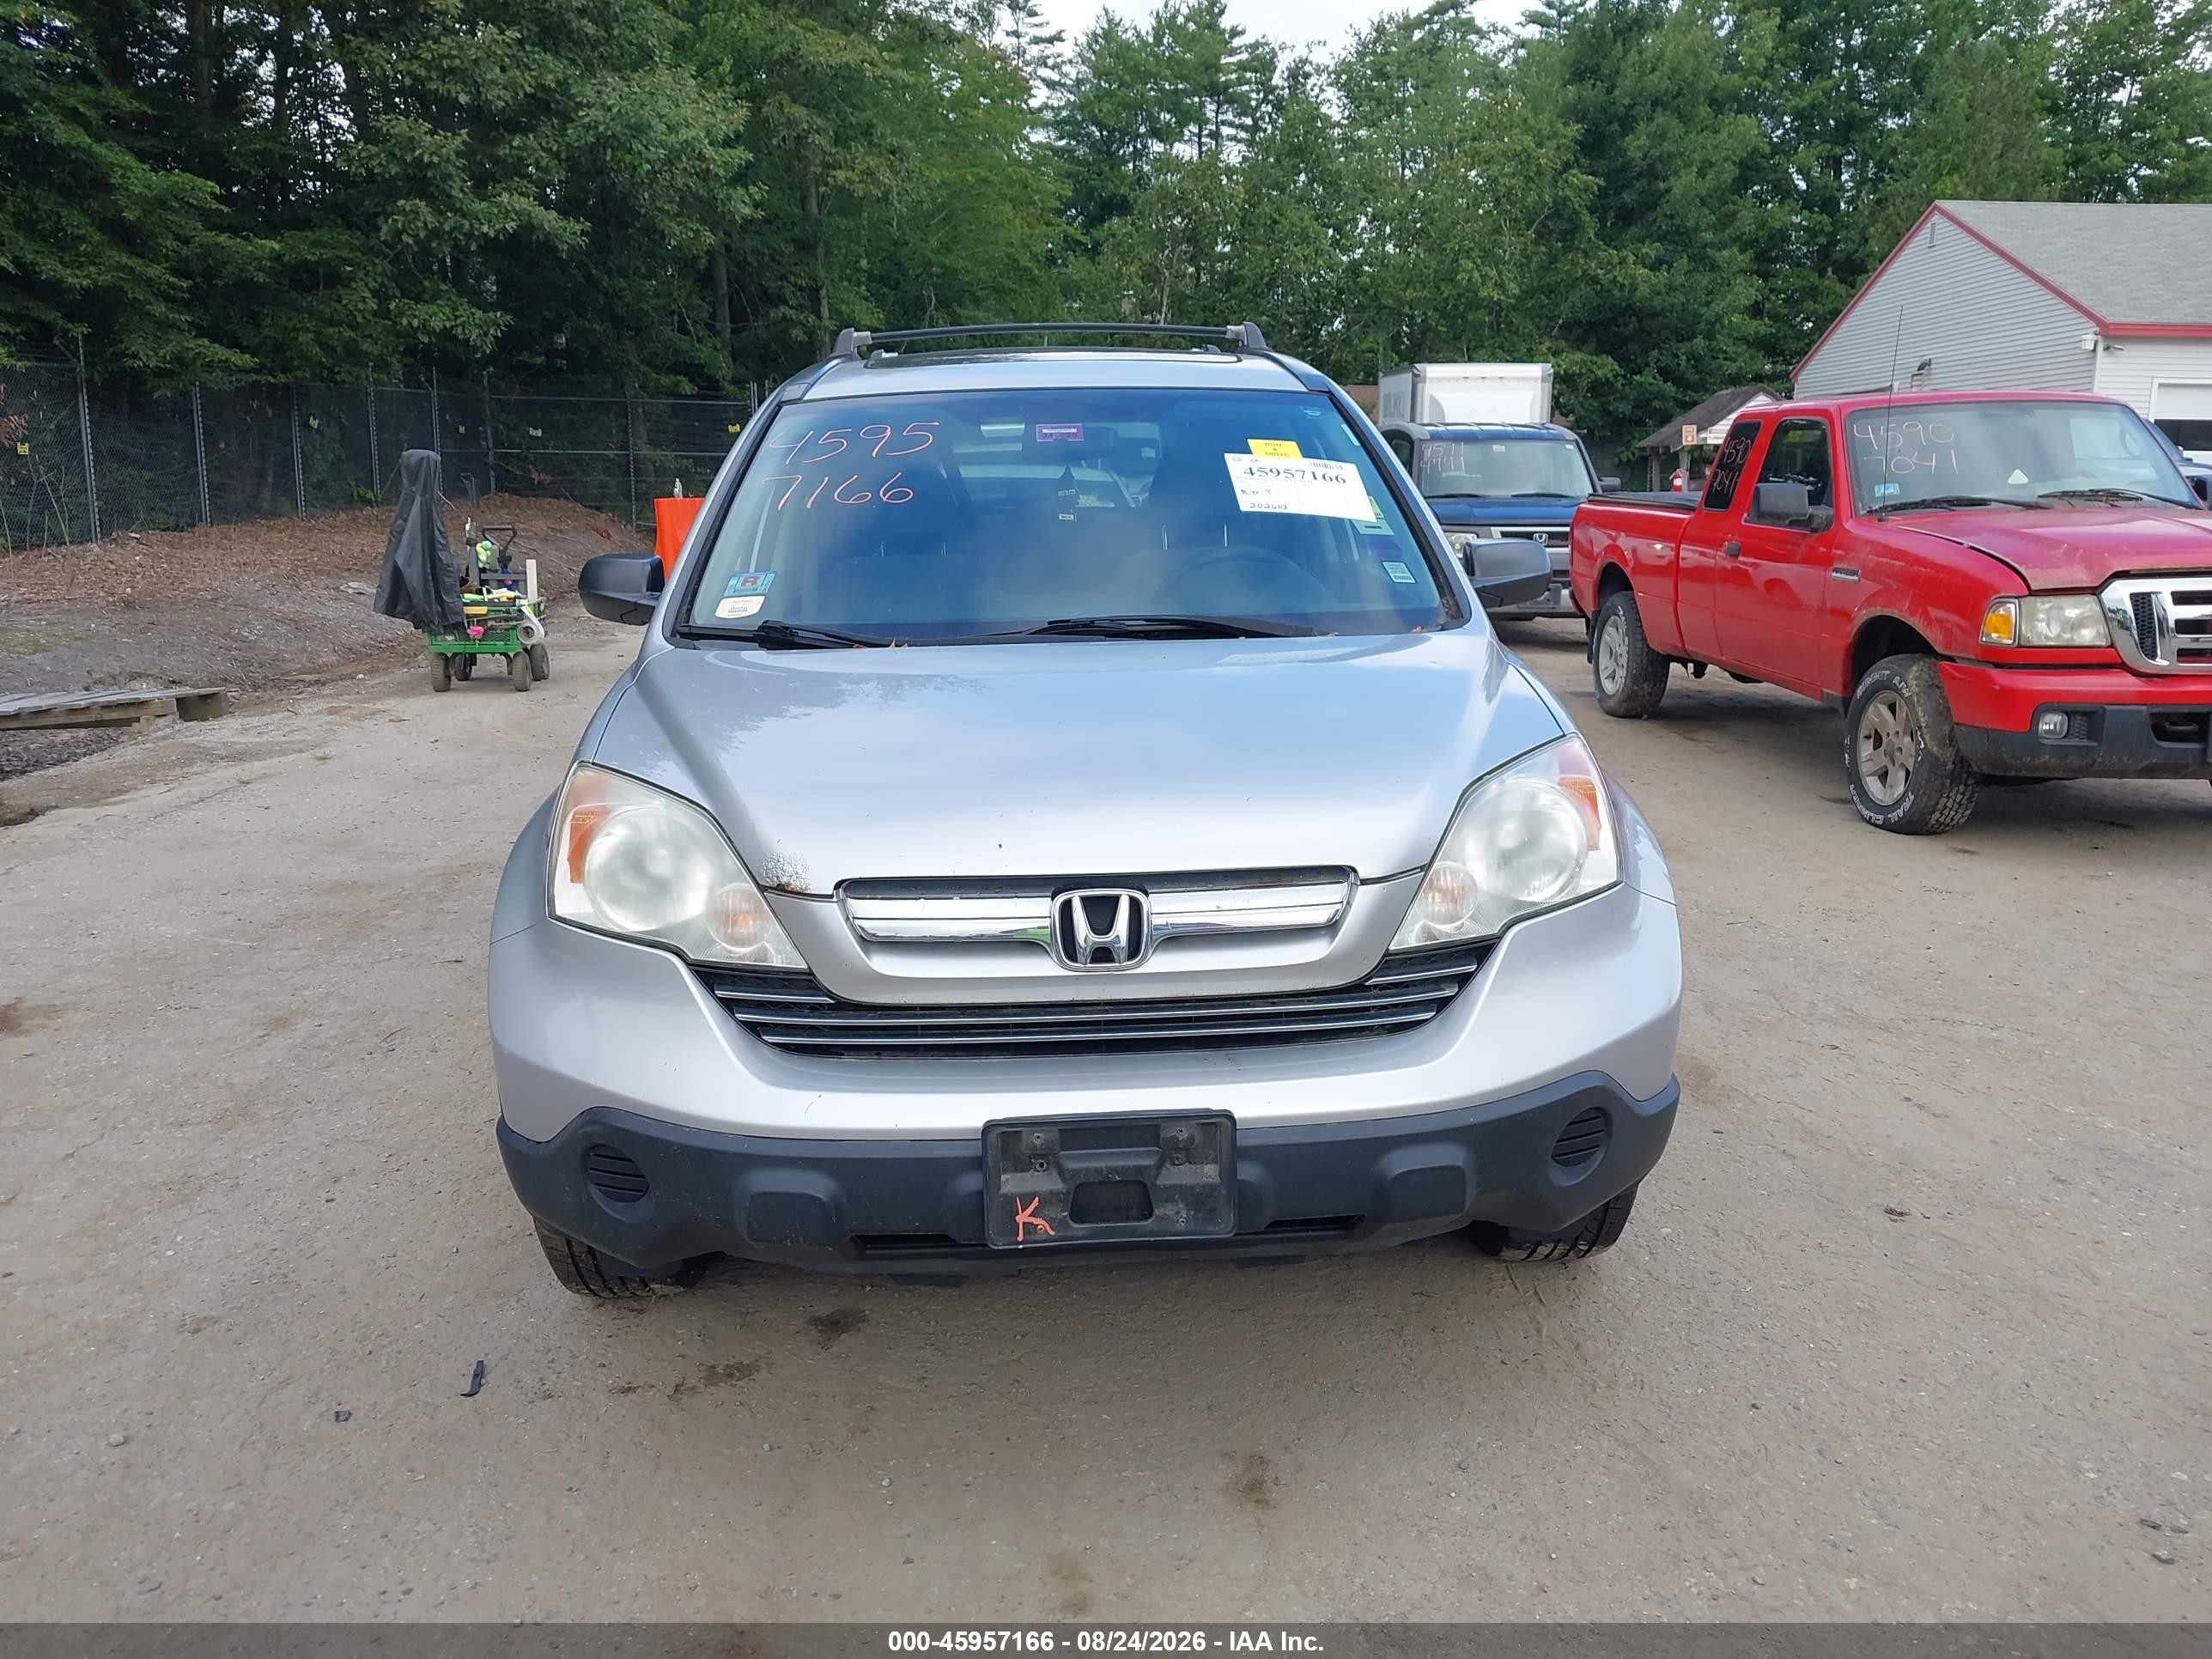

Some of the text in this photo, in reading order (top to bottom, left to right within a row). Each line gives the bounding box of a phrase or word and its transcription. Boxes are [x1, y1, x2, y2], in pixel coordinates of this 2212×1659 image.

[769, 422, 939, 465] 4595
[1724, 436, 1751, 464] 4590
[1853, 421, 1954, 451] 4590
[1243, 466, 1347, 484] 45957166
[1863, 450, 1959, 474] 7041
[762, 471, 914, 511] 7166
[1712, 468, 1739, 498] 7041
[1887, 791, 1915, 823] TRAIL
[1015, 1195, 1055, 1242] K
